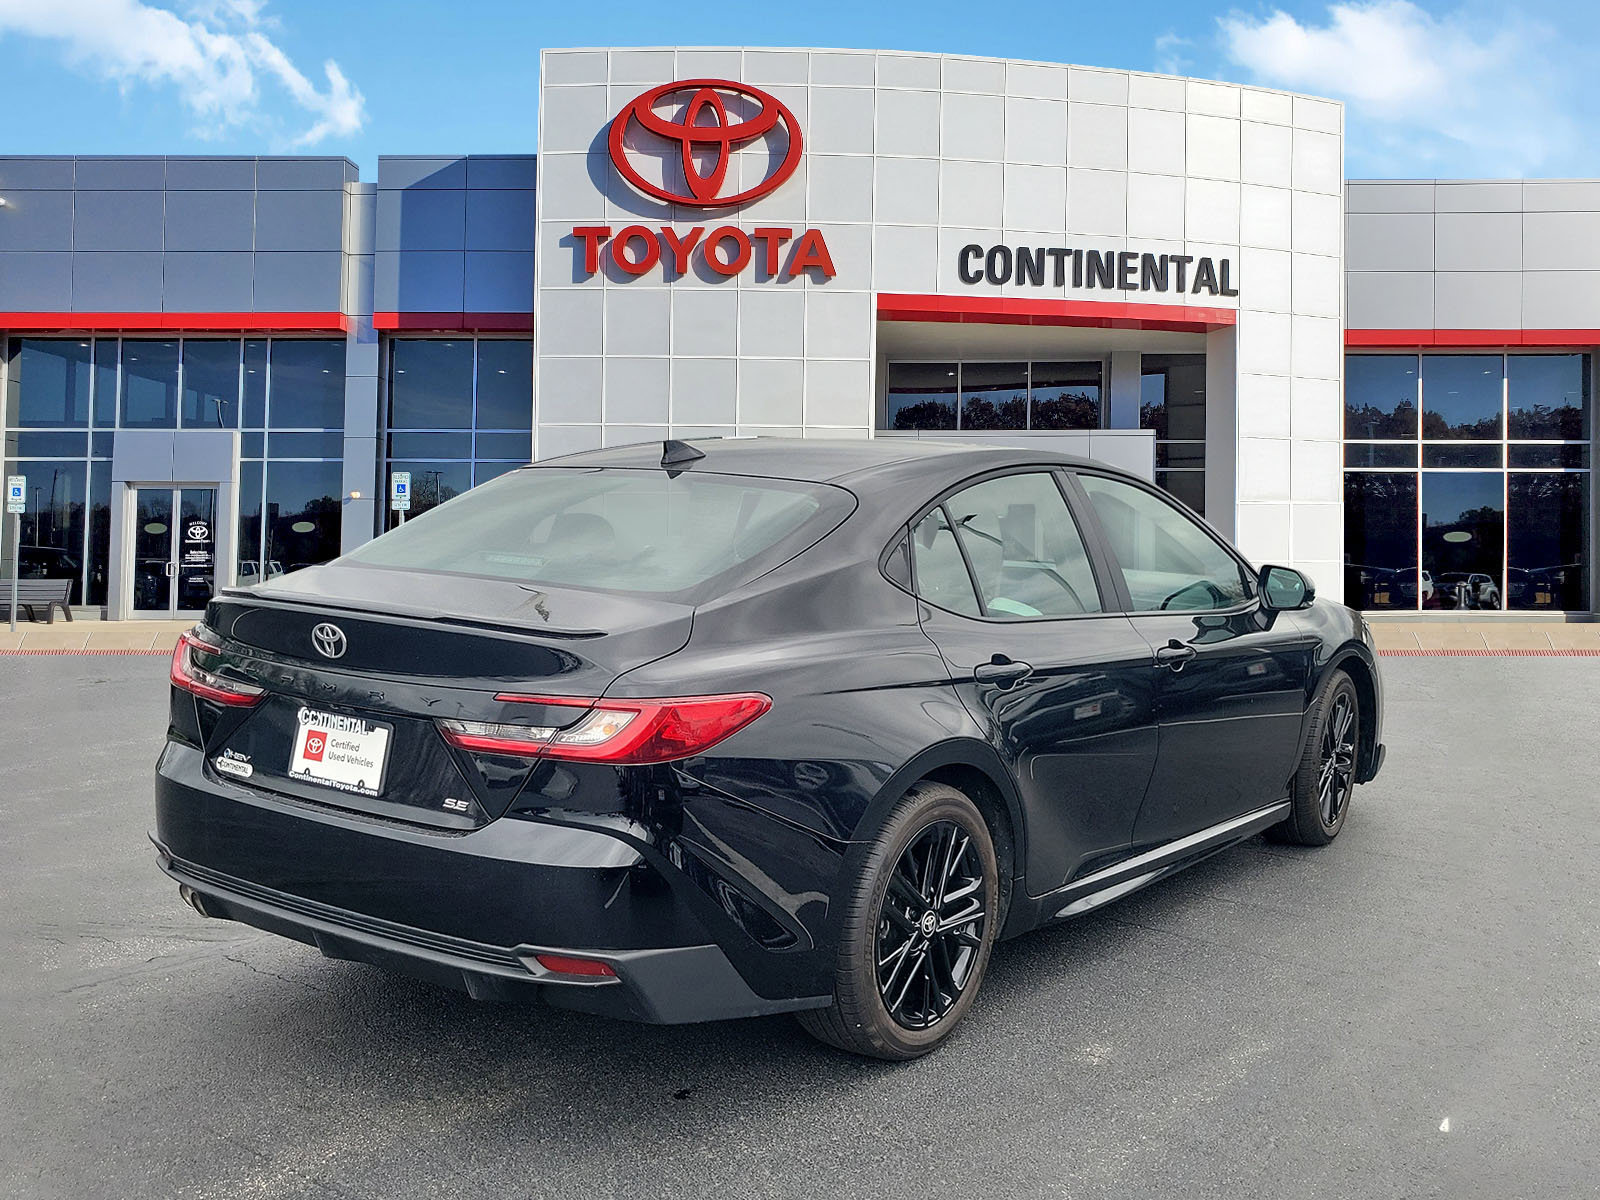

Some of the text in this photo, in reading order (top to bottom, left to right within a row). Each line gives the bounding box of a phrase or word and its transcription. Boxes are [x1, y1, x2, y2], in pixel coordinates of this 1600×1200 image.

[573, 224, 837, 277] TOYOTA
[958, 244, 1239, 297] CONTINENTAL
[298, 707, 369, 735] CONTINENTAL
[330, 738, 361, 752] Certified
[328, 751, 374, 768] Used Vehicles
[288, 770, 378, 797] ContinentalToyota.com
[442, 797, 470, 812] SE
